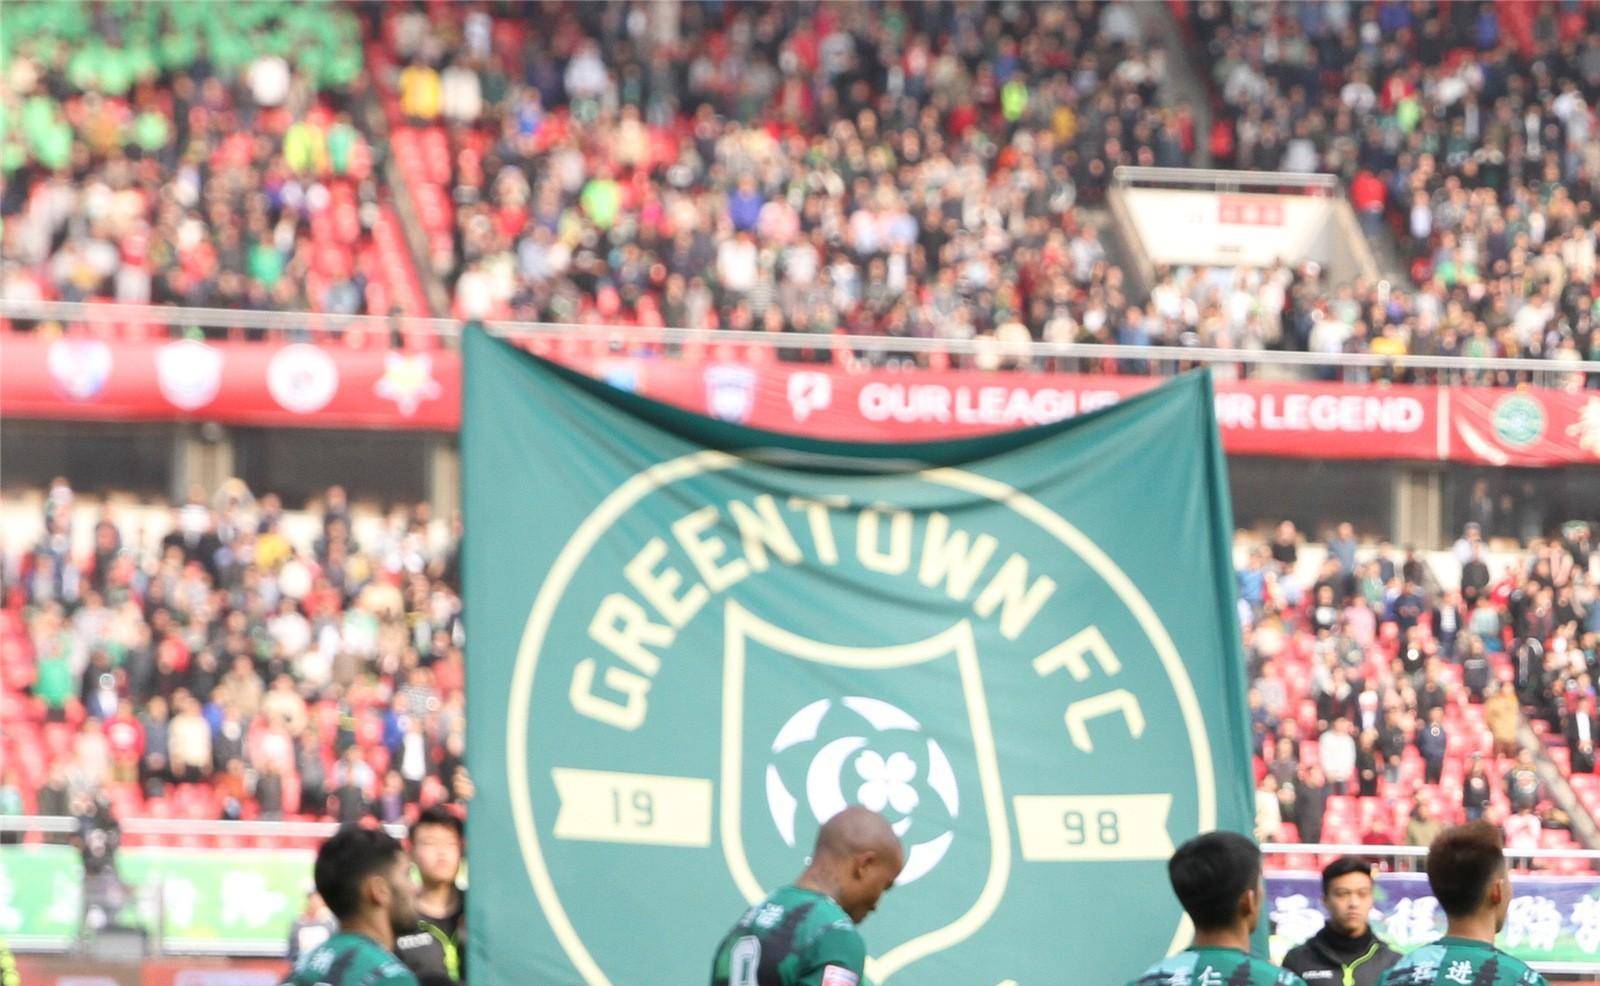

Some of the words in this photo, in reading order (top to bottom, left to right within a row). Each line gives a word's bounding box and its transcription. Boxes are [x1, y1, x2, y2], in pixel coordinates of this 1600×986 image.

[858, 382, 951, 424] OUR
[1260, 393, 1425, 433] LEGEND
[569, 494, 1056, 732] GREENTOWN
[1032, 625, 1146, 753] FC
[609, 789, 655, 826] 19
[1063, 811, 1120, 844] 98
